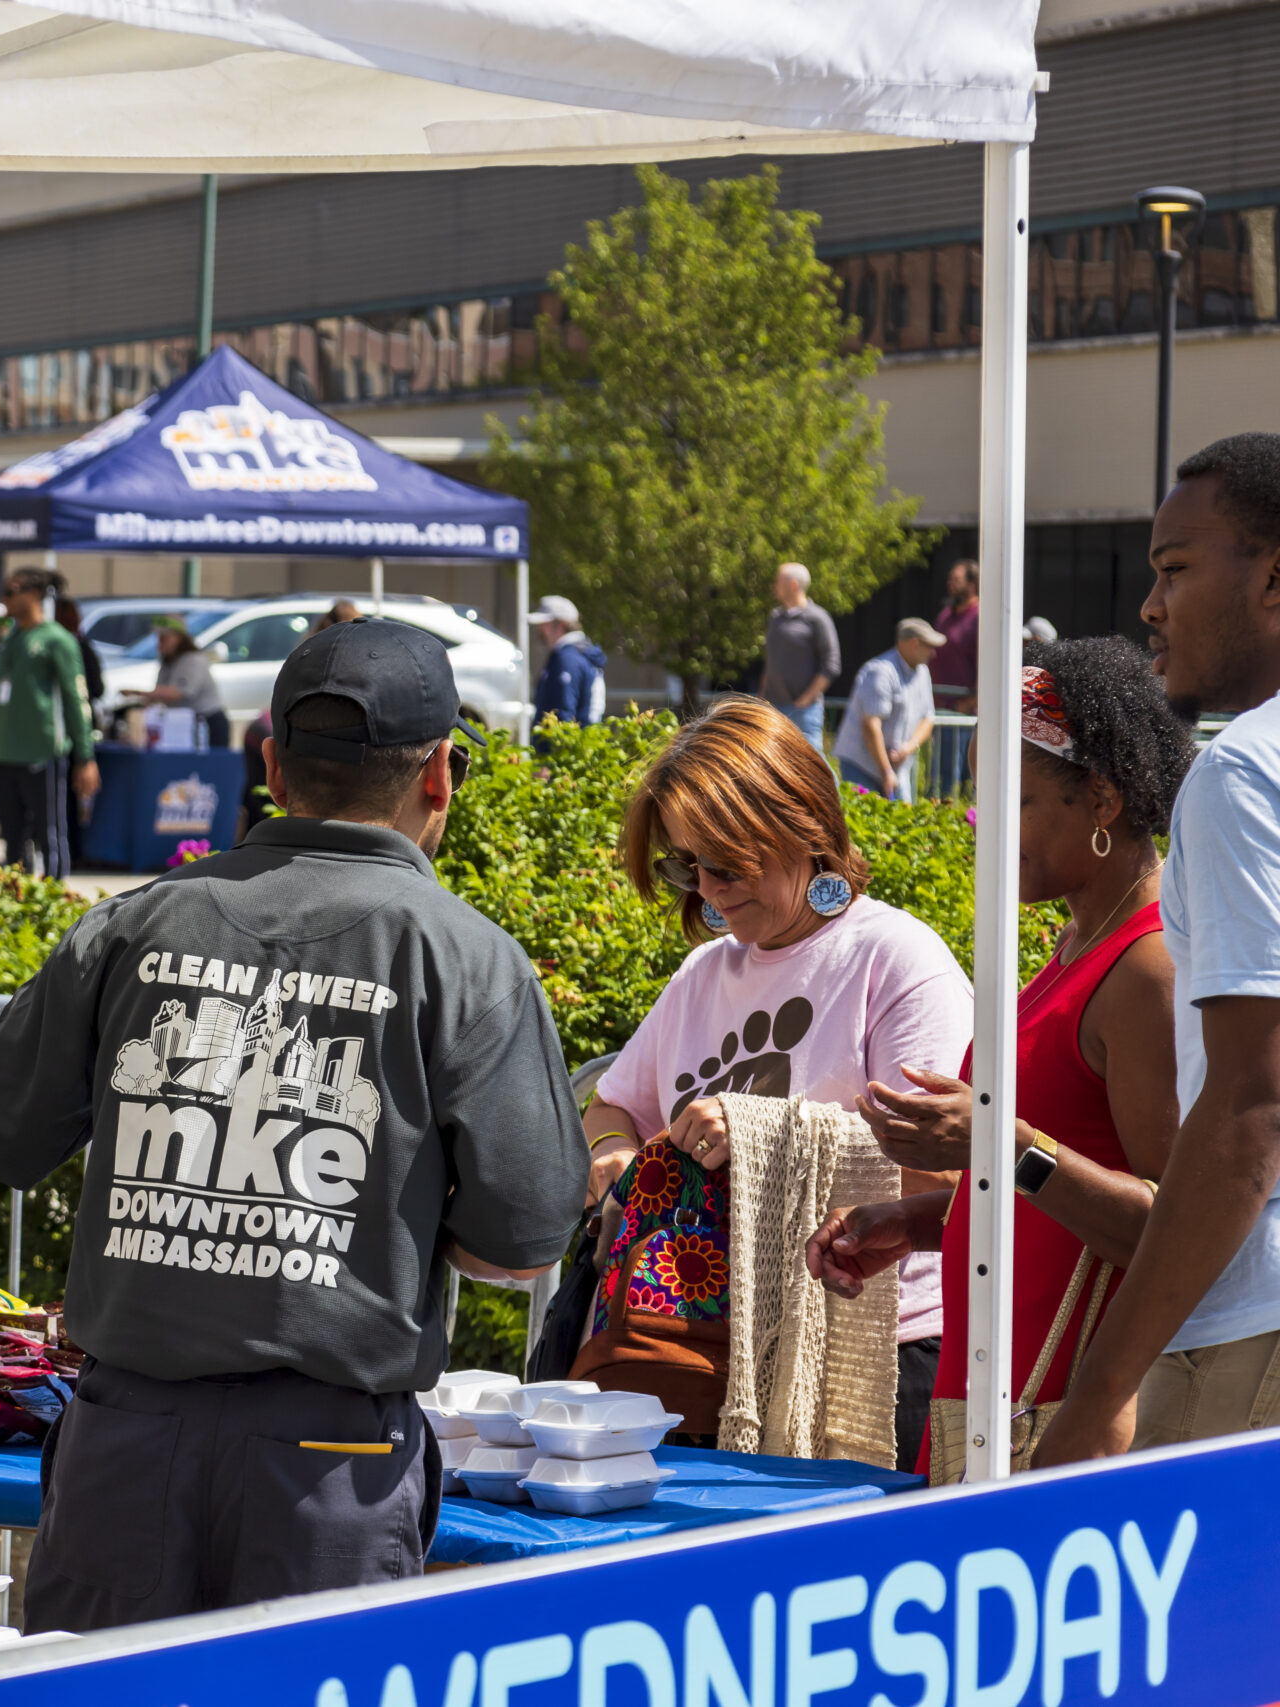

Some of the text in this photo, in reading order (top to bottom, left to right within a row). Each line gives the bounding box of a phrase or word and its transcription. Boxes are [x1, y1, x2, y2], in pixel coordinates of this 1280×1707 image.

[182, 432, 353, 470] mke
[95, 511, 486, 547] MilwaukeeDowntown.com
[138, 951, 398, 1015] CLEAN SWEEP
[114, 1067, 368, 1206] mke
[108, 1187, 356, 1252] DOWNTOWN
[103, 1227, 340, 1288] AMBASSADOR
[317, 1508, 1198, 1707] DNESDAY
